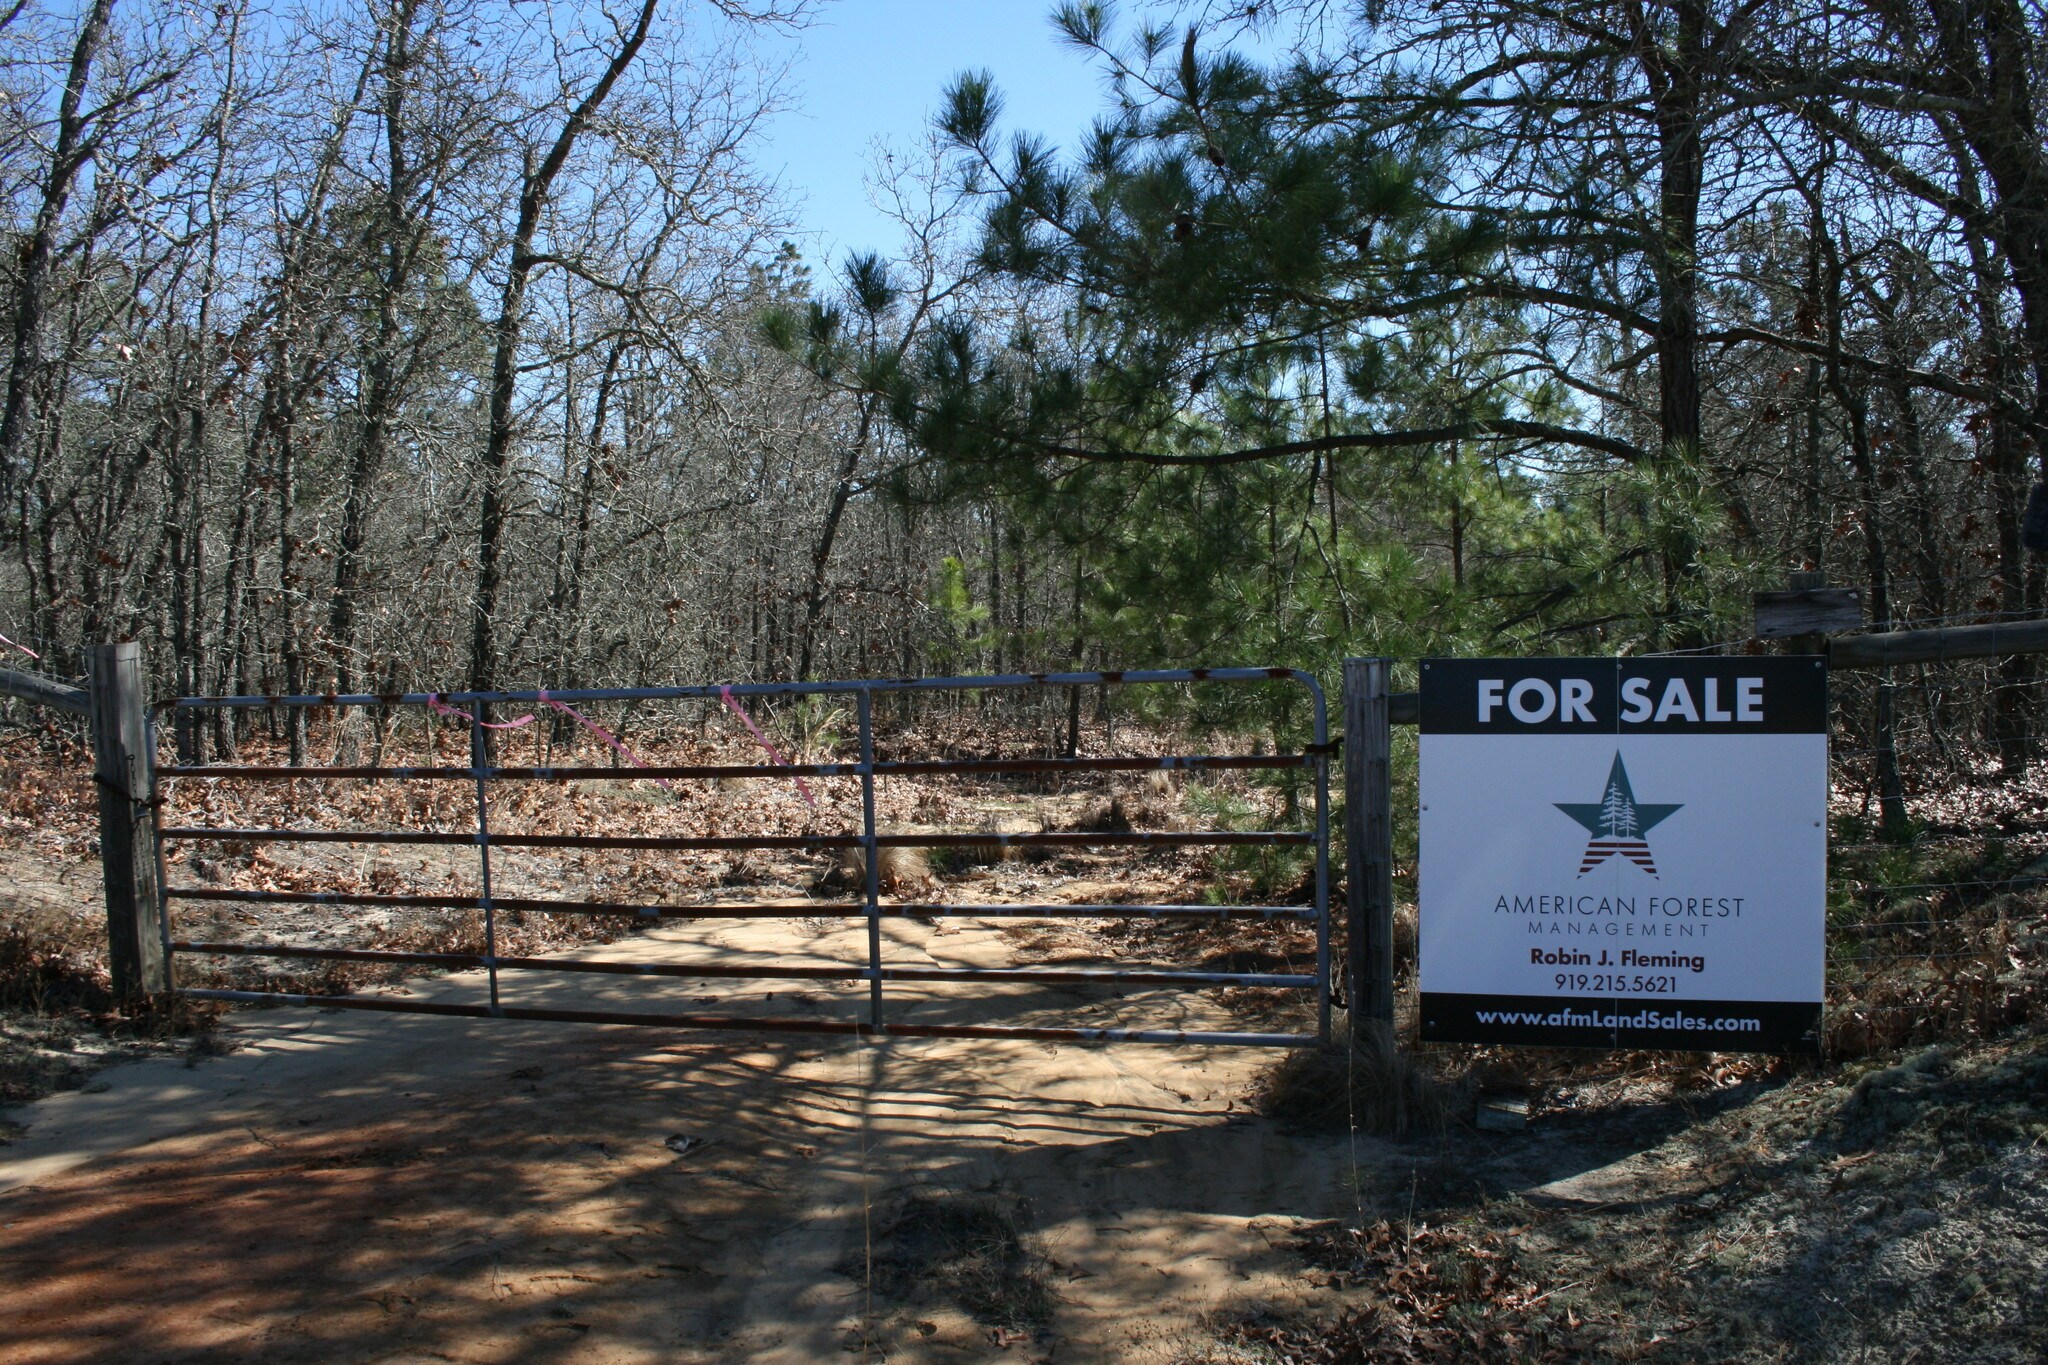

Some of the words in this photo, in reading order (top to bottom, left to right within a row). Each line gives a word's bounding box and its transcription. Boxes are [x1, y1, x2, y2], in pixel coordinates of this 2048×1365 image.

[1477, 677, 1597, 724] FOR
[1620, 677, 1764, 723] SALE
[1494, 895, 1636, 916] AMERICAN
[1649, 897, 1745, 917] FOREST
[1528, 921, 1709, 937] MANAGEMENT
[1530, 947, 1591, 966] Robin
[1597, 949, 1614, 967] J.
[1621, 949, 1705, 972] Fleming
[1554, 973, 1677, 993] 919.215.5621
[1476, 1007, 1761, 1032] www.afmLandSales.com
